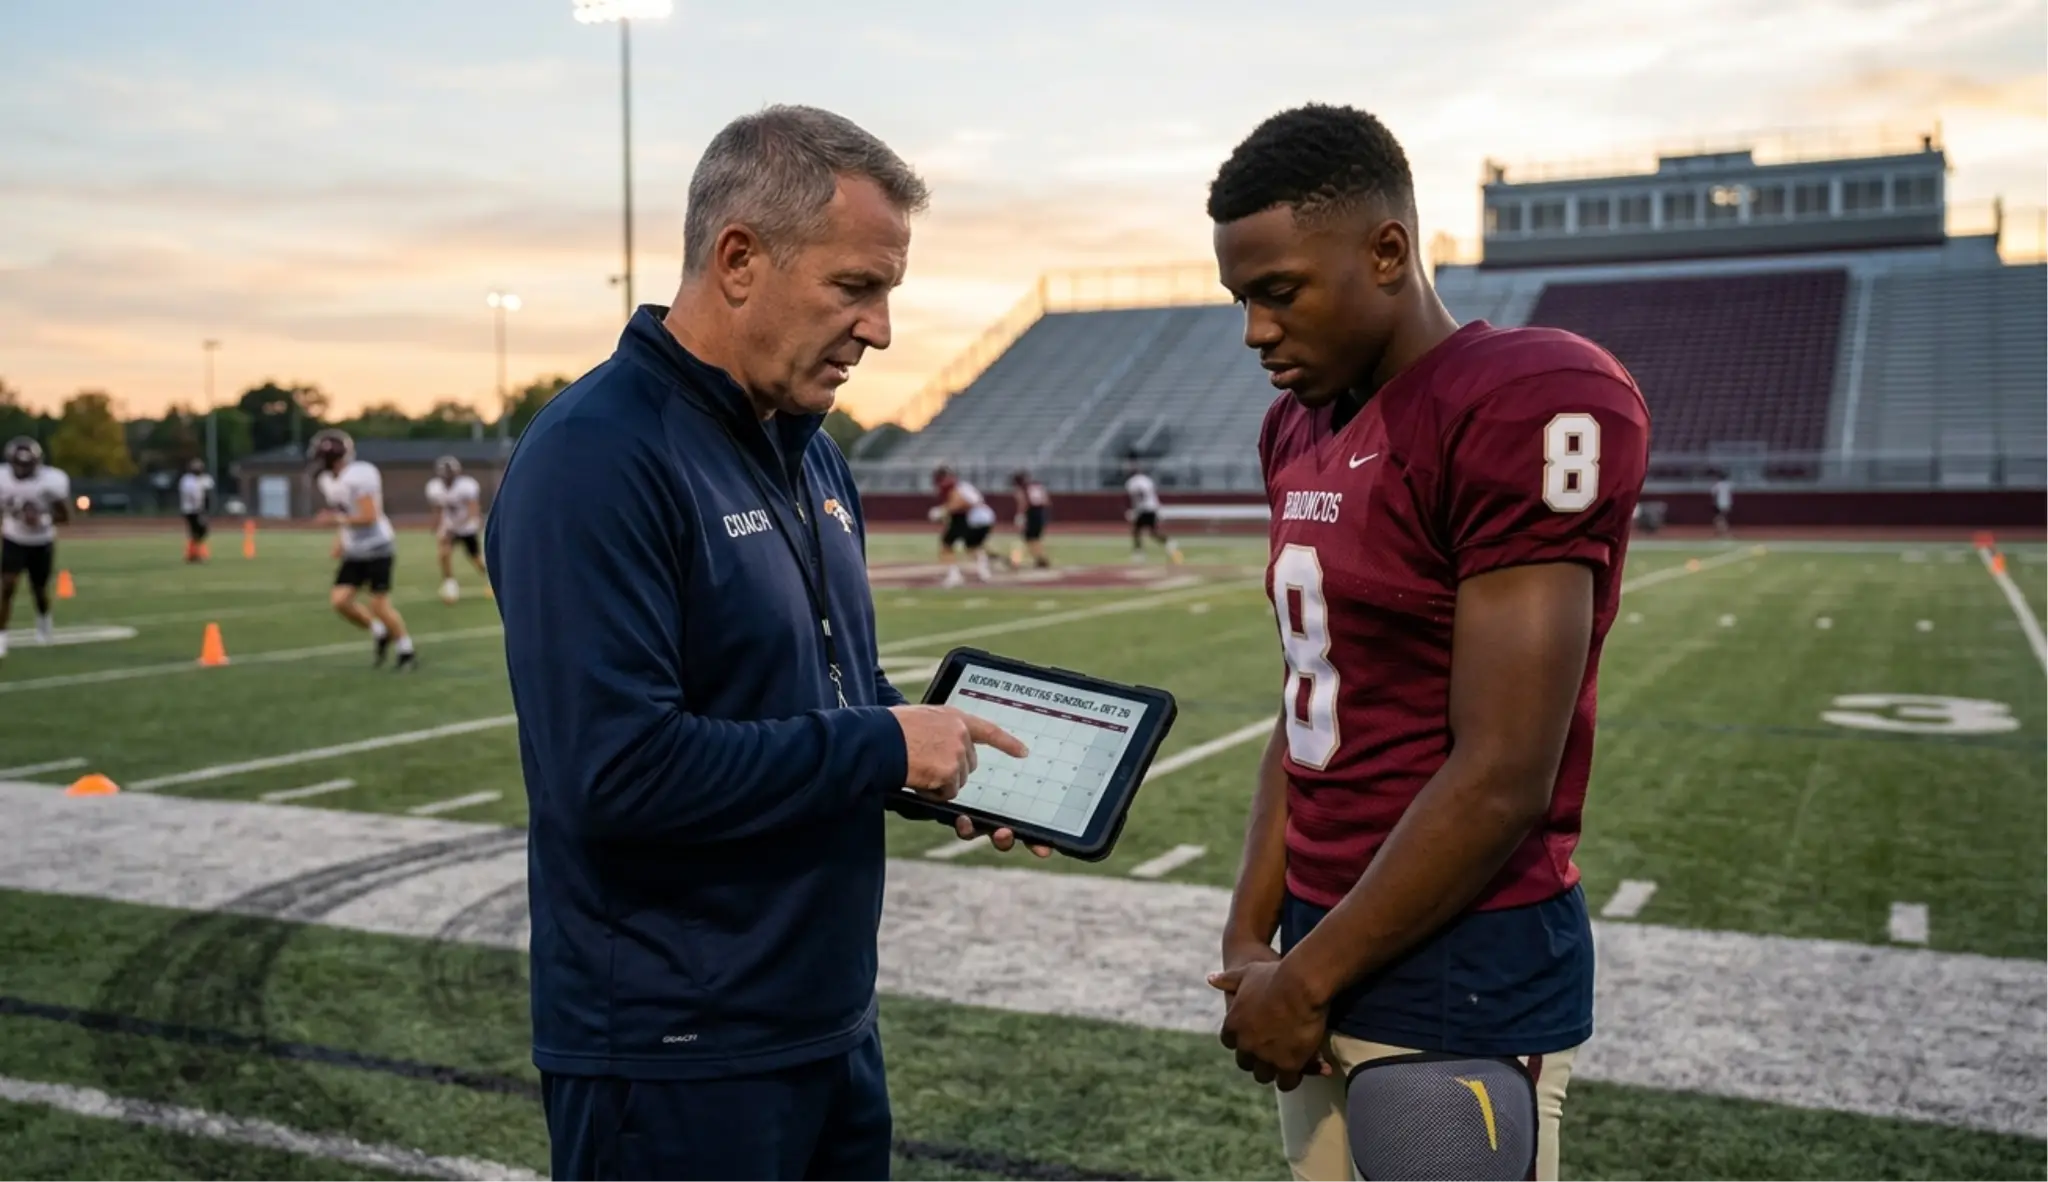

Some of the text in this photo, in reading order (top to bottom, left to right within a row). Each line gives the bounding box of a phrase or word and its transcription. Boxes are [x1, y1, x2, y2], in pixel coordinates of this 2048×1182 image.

[1542, 412, 1601, 513] 8
[723, 509, 773, 538] COACH
[1282, 490, 1343, 523] BRONCOS
[1273, 542, 1341, 772] 8
